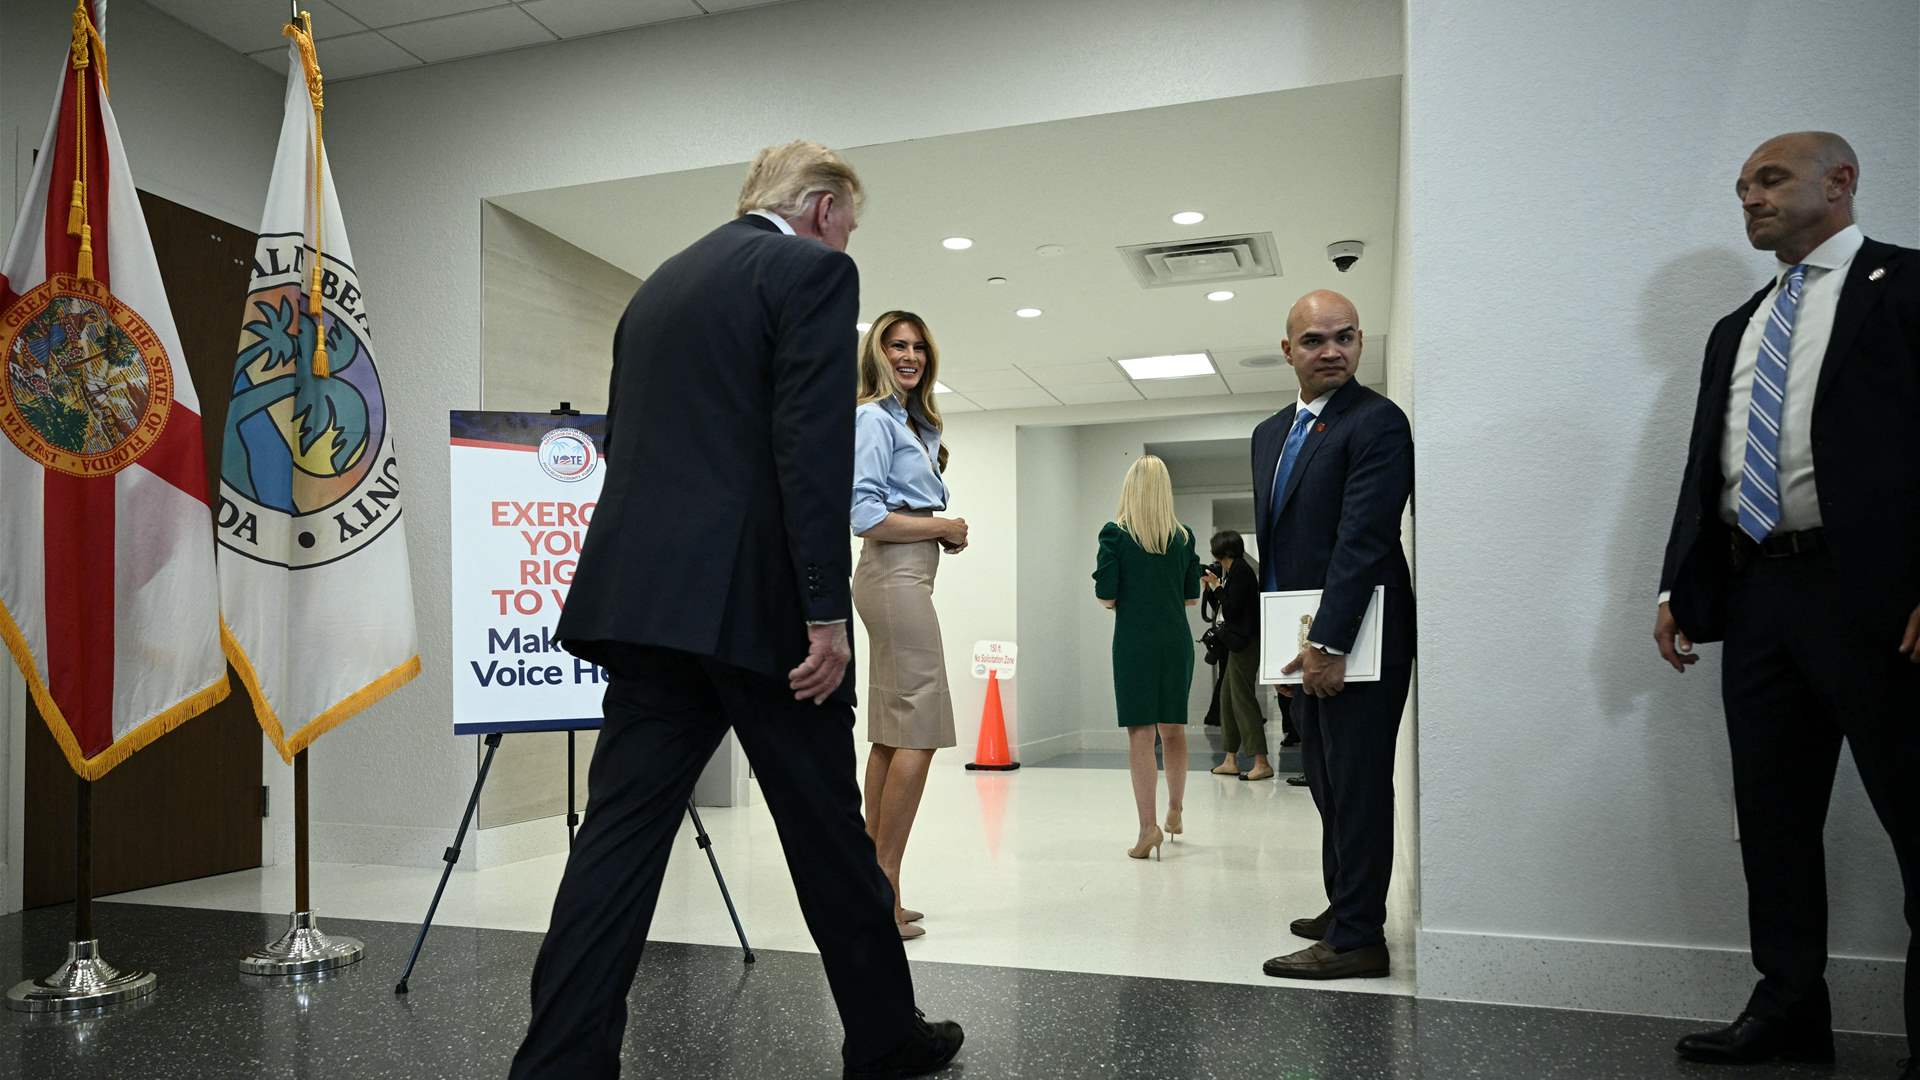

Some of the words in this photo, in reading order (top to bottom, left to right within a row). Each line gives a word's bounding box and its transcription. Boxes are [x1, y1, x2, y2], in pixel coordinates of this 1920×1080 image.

[56, 278, 100, 298] SEAL
[6, 287, 51, 327] GREAT
[124, 316, 156, 349] THE
[150, 356, 169, 406] STATE
[4, 411, 25, 437] WE
[144, 413, 162, 436] OF
[81, 435, 148, 472] FLORIDA
[491, 501, 598, 527] EXERC
[519, 559, 577, 585] RIG
[491, 589, 543, 615] TO
[488, 626, 561, 654] Mak
[470, 659, 563, 687] Voice
